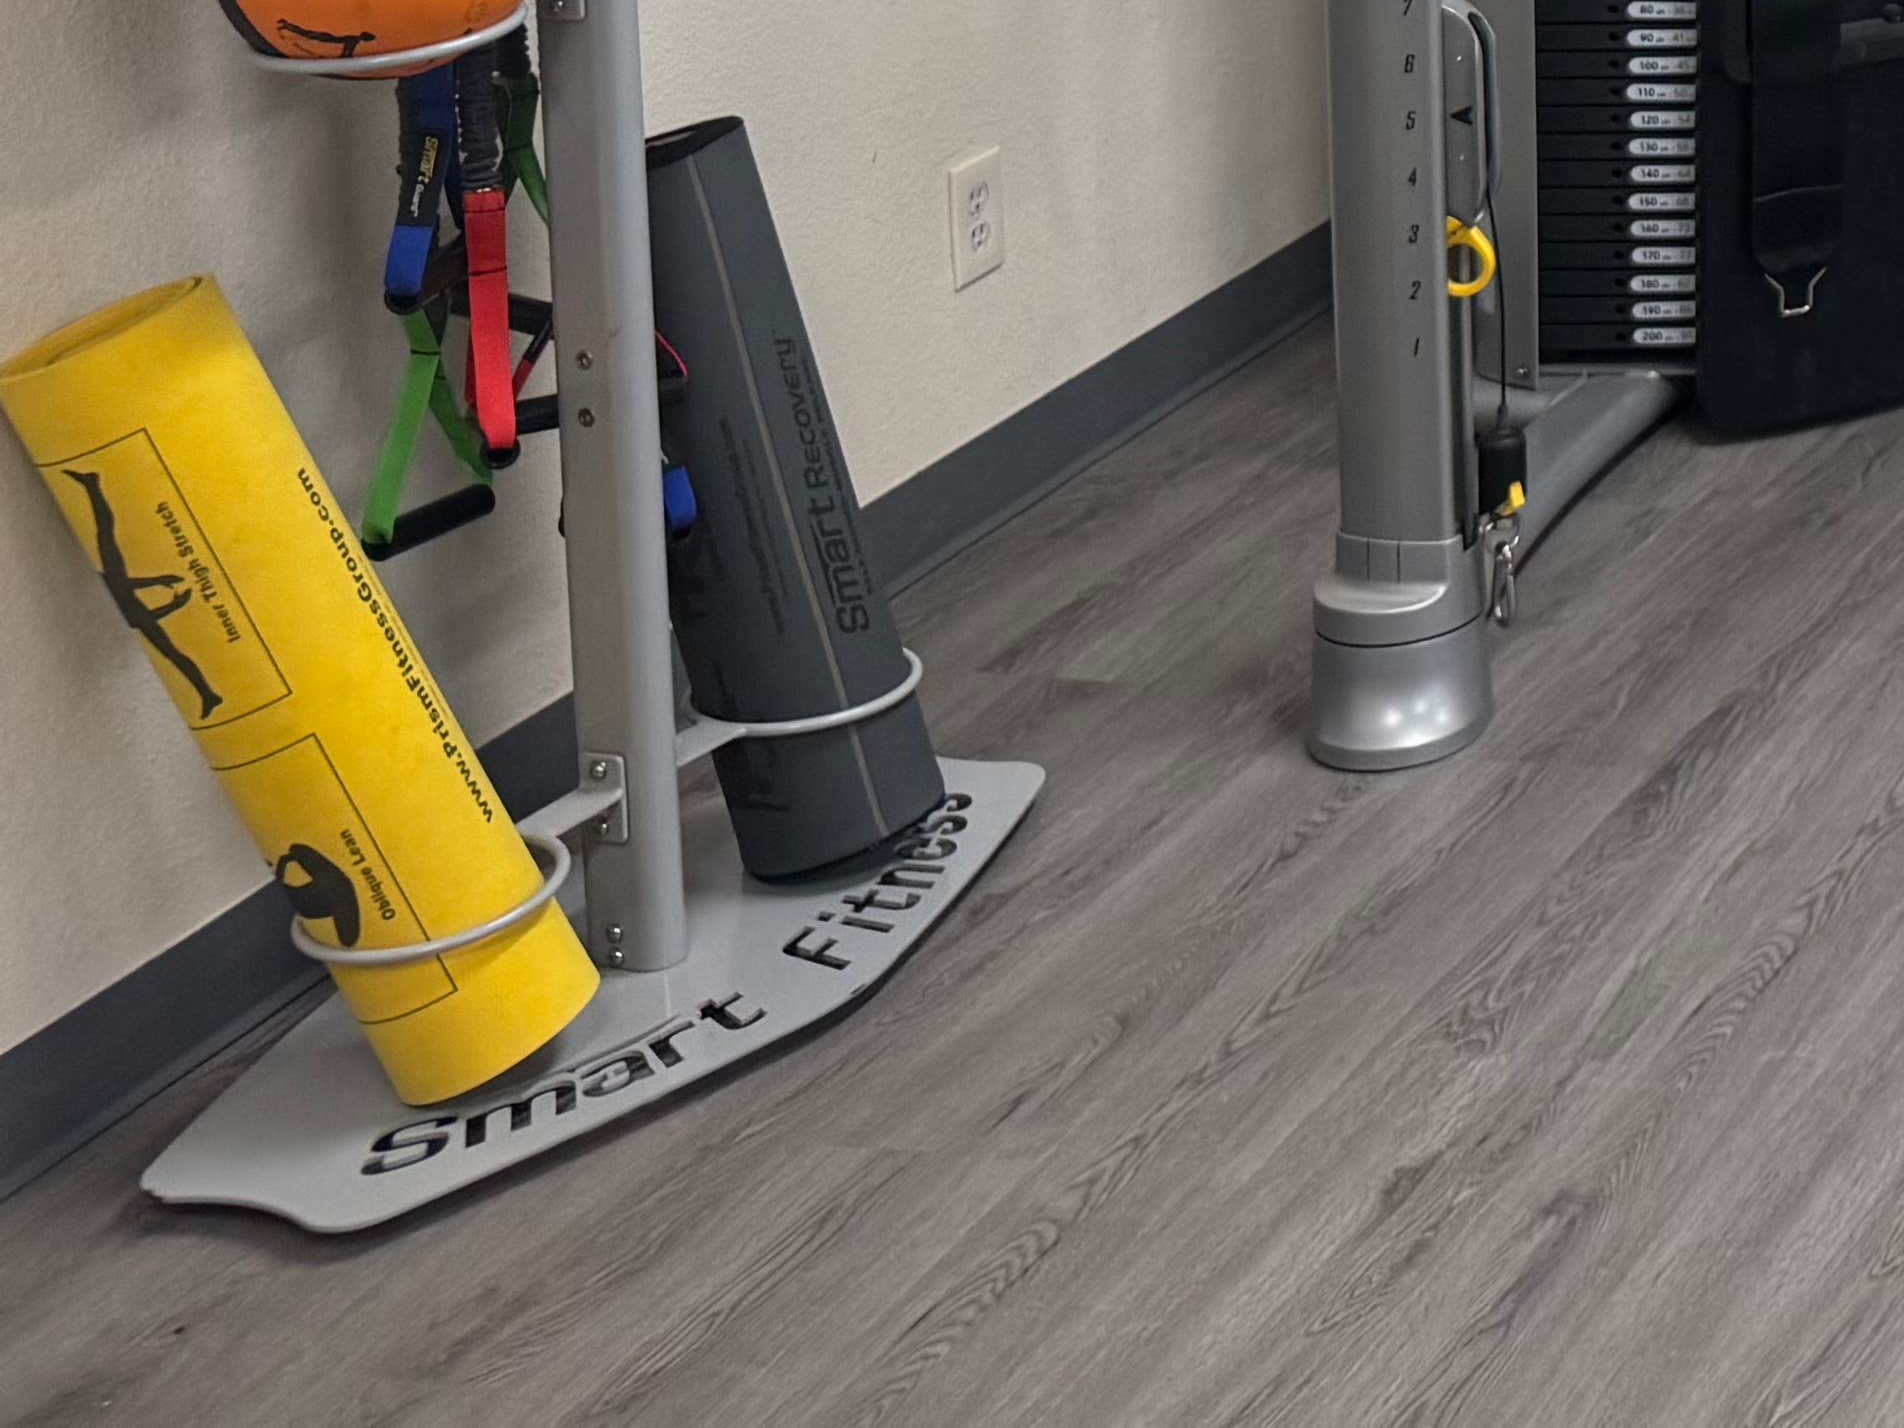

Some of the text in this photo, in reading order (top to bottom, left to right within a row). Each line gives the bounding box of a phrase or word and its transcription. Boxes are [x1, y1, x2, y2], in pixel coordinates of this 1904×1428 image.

[1404, 55, 1415, 72] 6
[1409, 225, 1419, 243] 3
[1409, 281, 1421, 300] 2
[156, 501, 241, 643] Inner Thigh Stretch
[808, 495, 870, 634] Smart
[298, 468, 493, 823] www.PrismFitnessGroup.com
[340, 829, 396, 920] Oblique Lean
[360, 992, 768, 1176] Smart
